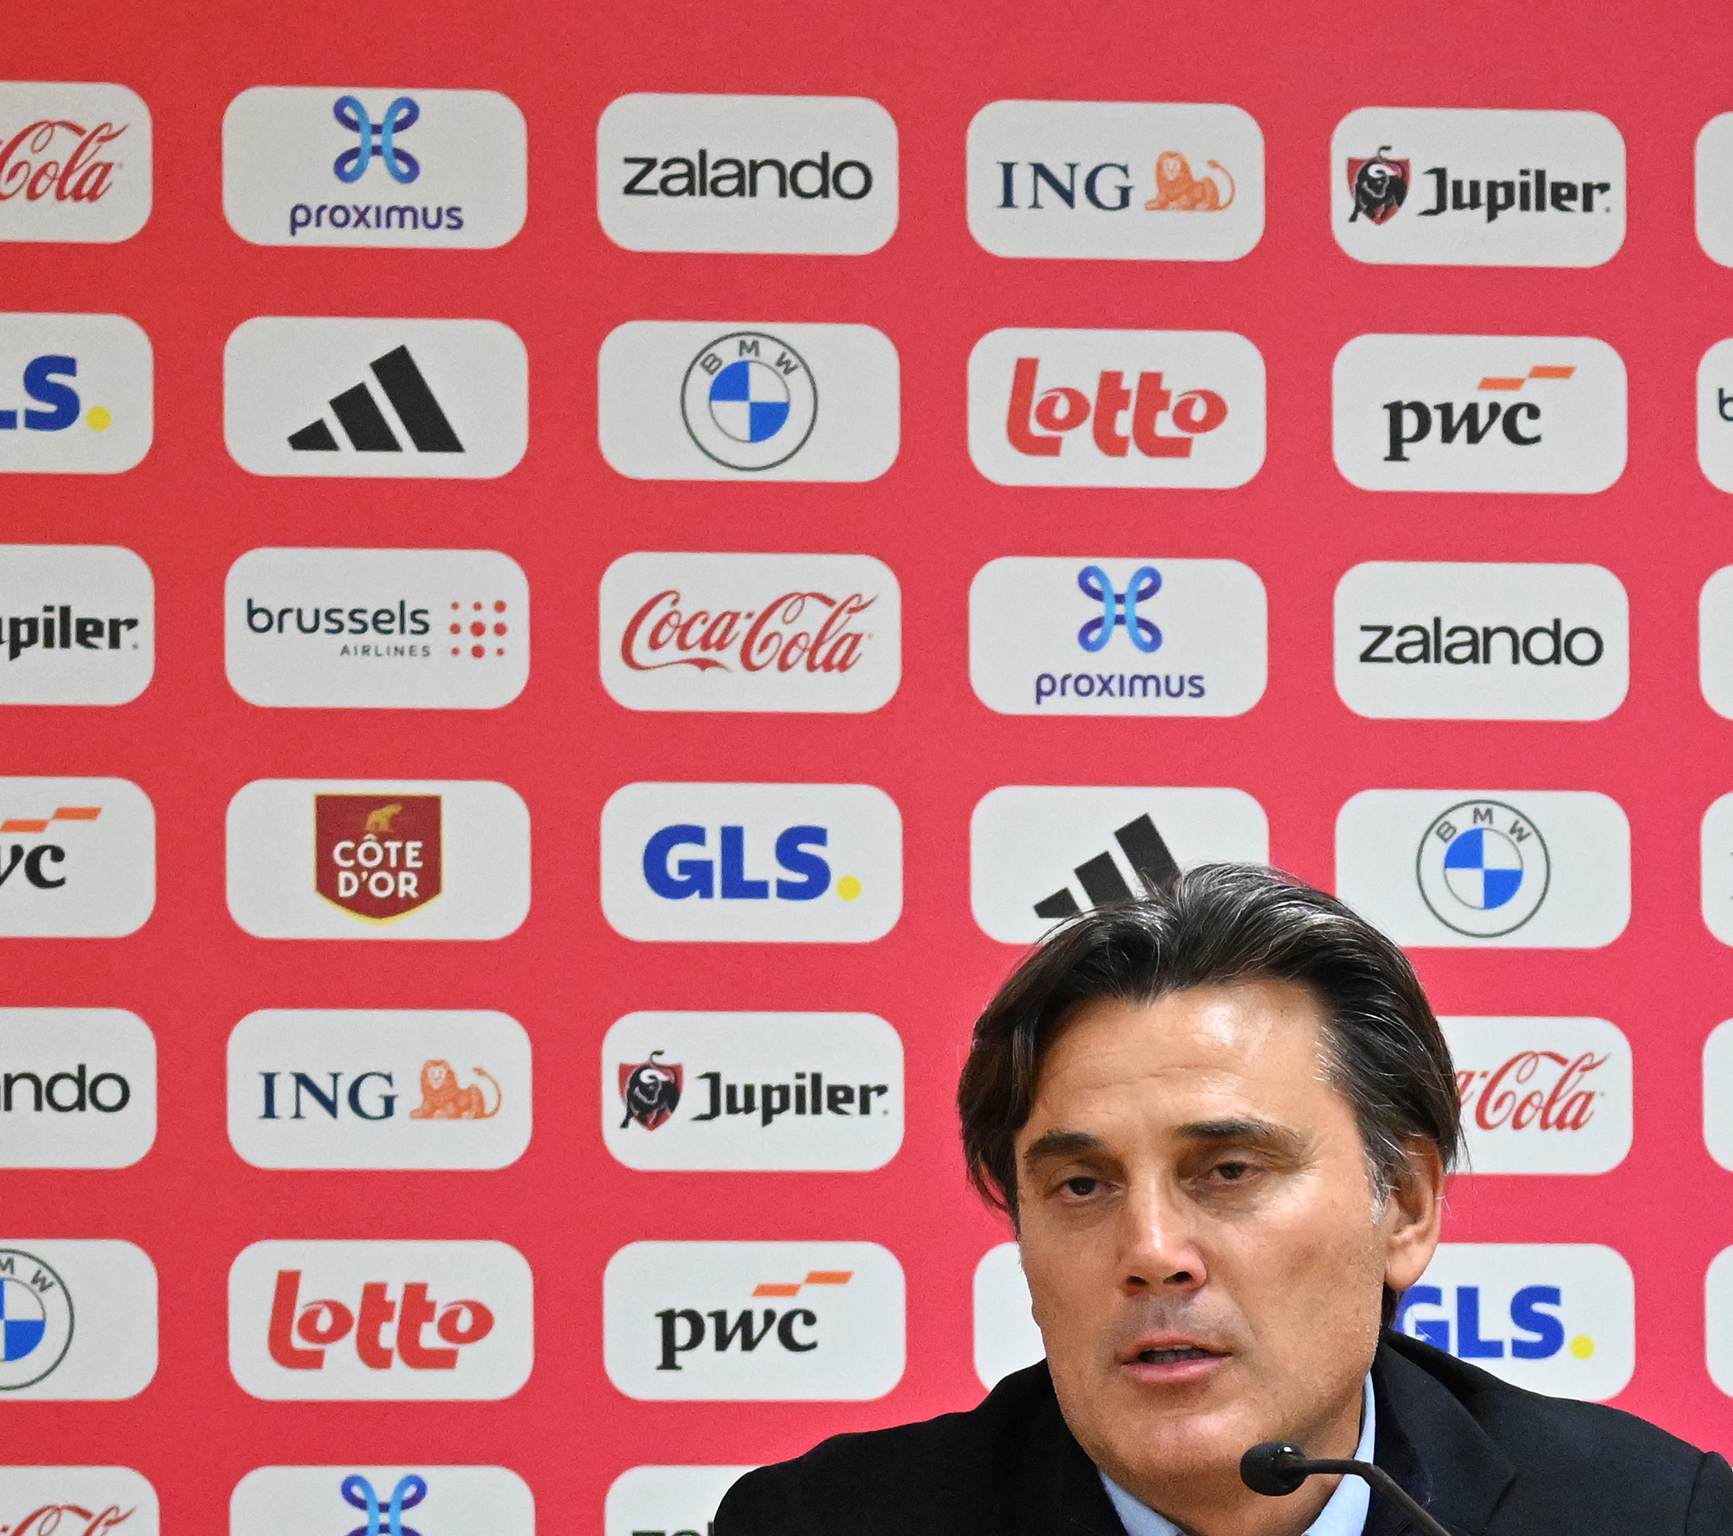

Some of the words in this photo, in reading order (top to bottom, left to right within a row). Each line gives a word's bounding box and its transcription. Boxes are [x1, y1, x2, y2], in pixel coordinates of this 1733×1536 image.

[622, 148, 874, 201] zalando
[996, 161, 1135, 212] ING
[1417, 166, 1611, 224] Jupiler
[289, 203, 464, 237] proximus
[696, 334, 801, 377] BMW
[1382, 399, 1542, 462] pwc
[245, 597, 431, 637] brussels
[620, 589, 877, 674] Coca-Cola
[1359, 615, 1605, 667] zalando
[339, 644, 431, 658] AIRLINES
[1035, 672, 1206, 706] proximus
[1431, 802, 1535, 845] BMW
[333, 833, 423, 869] CÔTE
[257, 1071, 399, 1121] ING
[690, 1071, 889, 1128] Jupiler
[654, 1308, 819, 1372] pwc
